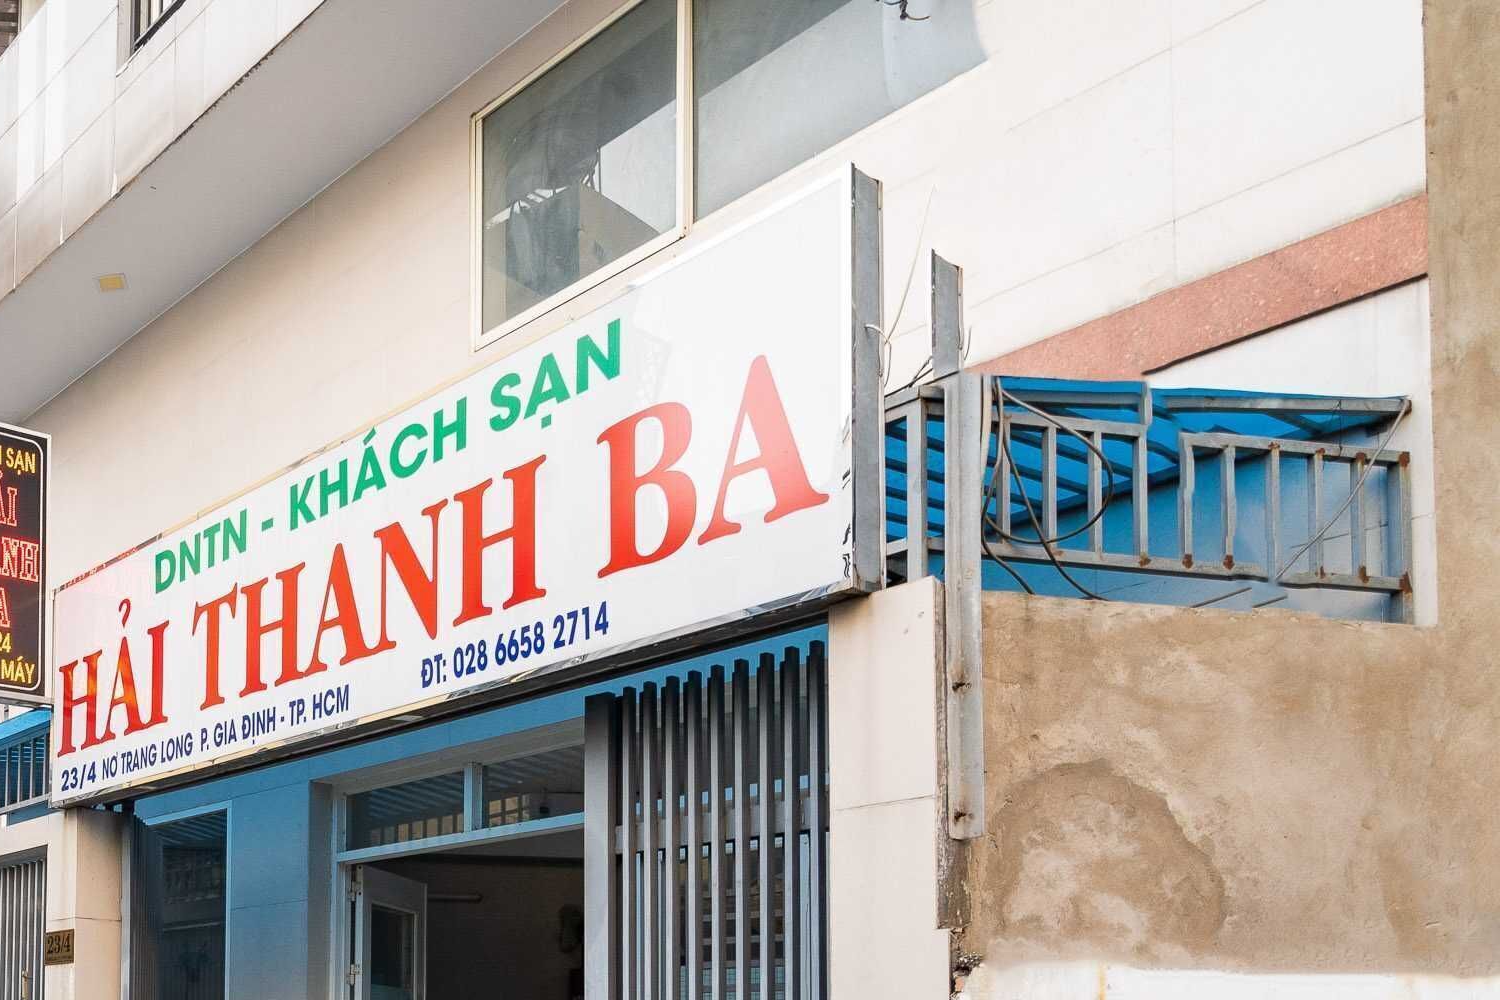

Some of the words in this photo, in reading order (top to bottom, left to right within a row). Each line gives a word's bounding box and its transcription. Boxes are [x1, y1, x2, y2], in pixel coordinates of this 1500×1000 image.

[6, 447, 36, 476] SẠN
[155, 508, 247, 594] DNTN
[289, 396, 468, 531] KHÁCH
[489, 317, 621, 431] SẠN
[57, 598, 171, 758] HẢI
[192, 453, 547, 711] THANH
[596, 354, 830, 579] BA
[1, 654, 36, 684] MÁY
[420, 653, 448, 689] ĐT:
[453, 639, 489, 679] 028
[494, 620, 546, 666] 6658
[552, 600, 610, 650] 2714
[60, 761, 97, 792] 23/4
[120, 743, 158, 775] TRANG
[160, 732, 194, 763] LONG
[200, 727, 209, 752] P.
[213, 718, 238, 748] GIA
[241, 706, 276, 745] ĐỊNH
[288, 697, 307, 727] TP.
[312, 683, 350, 721] HCM
[47, 933, 71, 954] 23/4
